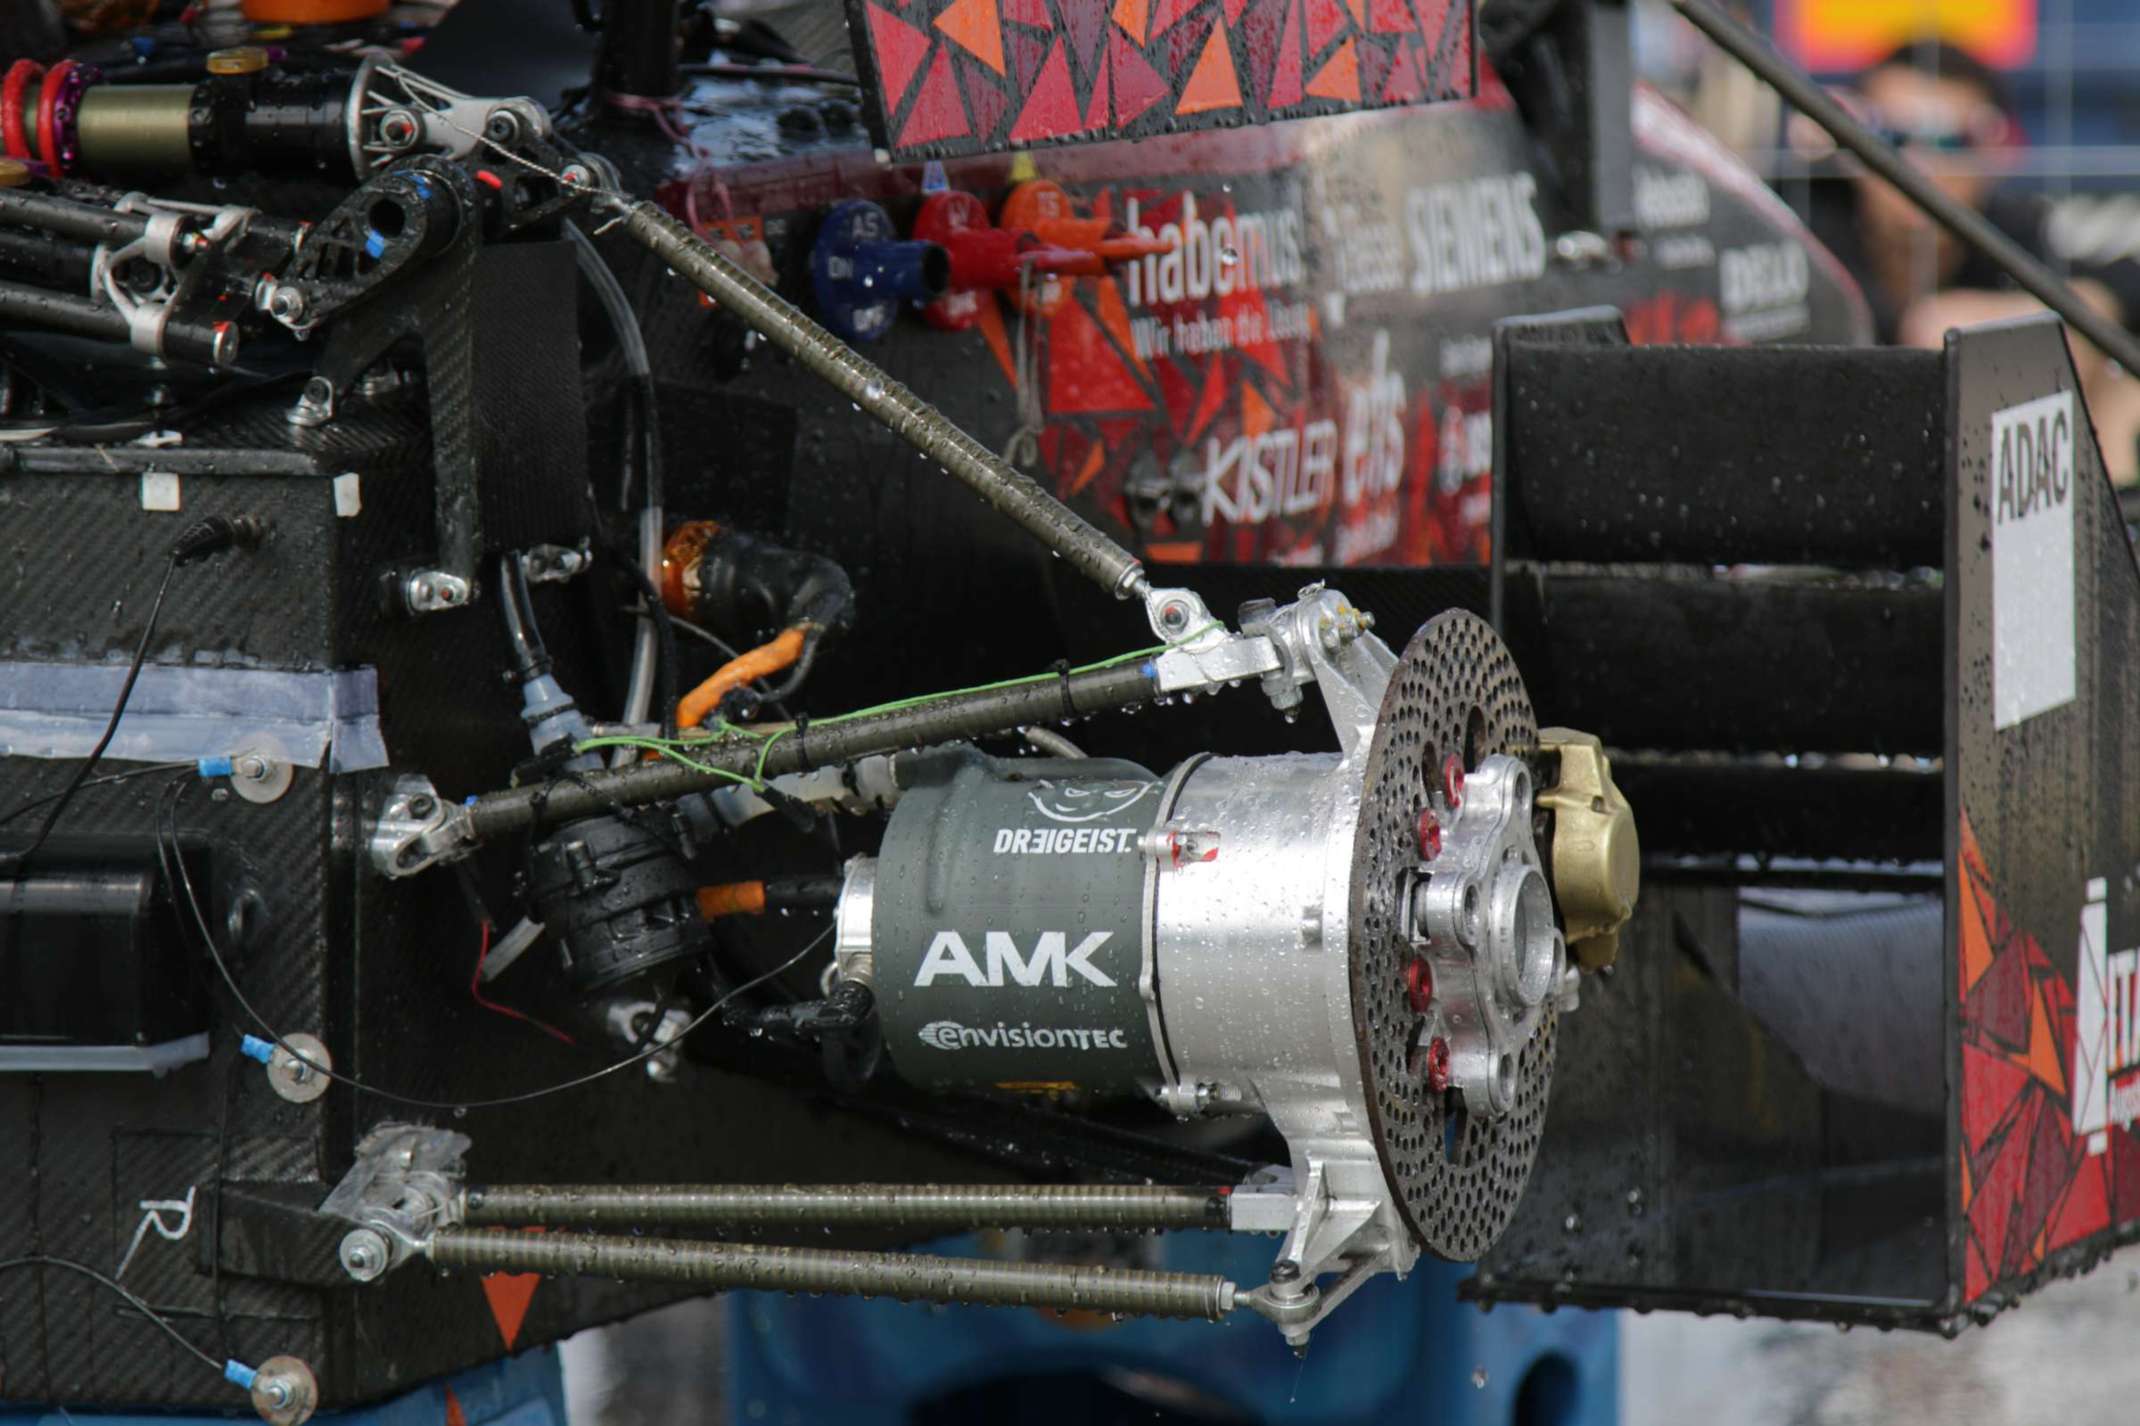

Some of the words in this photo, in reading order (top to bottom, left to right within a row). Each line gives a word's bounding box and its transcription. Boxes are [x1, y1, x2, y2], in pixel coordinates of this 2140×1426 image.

[851, 210, 879, 240] AS
[1127, 190, 1300, 306] habemus
[1132, 315, 1170, 359] Wir
[1999, 408, 2069, 524] ADAC
[913, 930, 1119, 988] AMK
